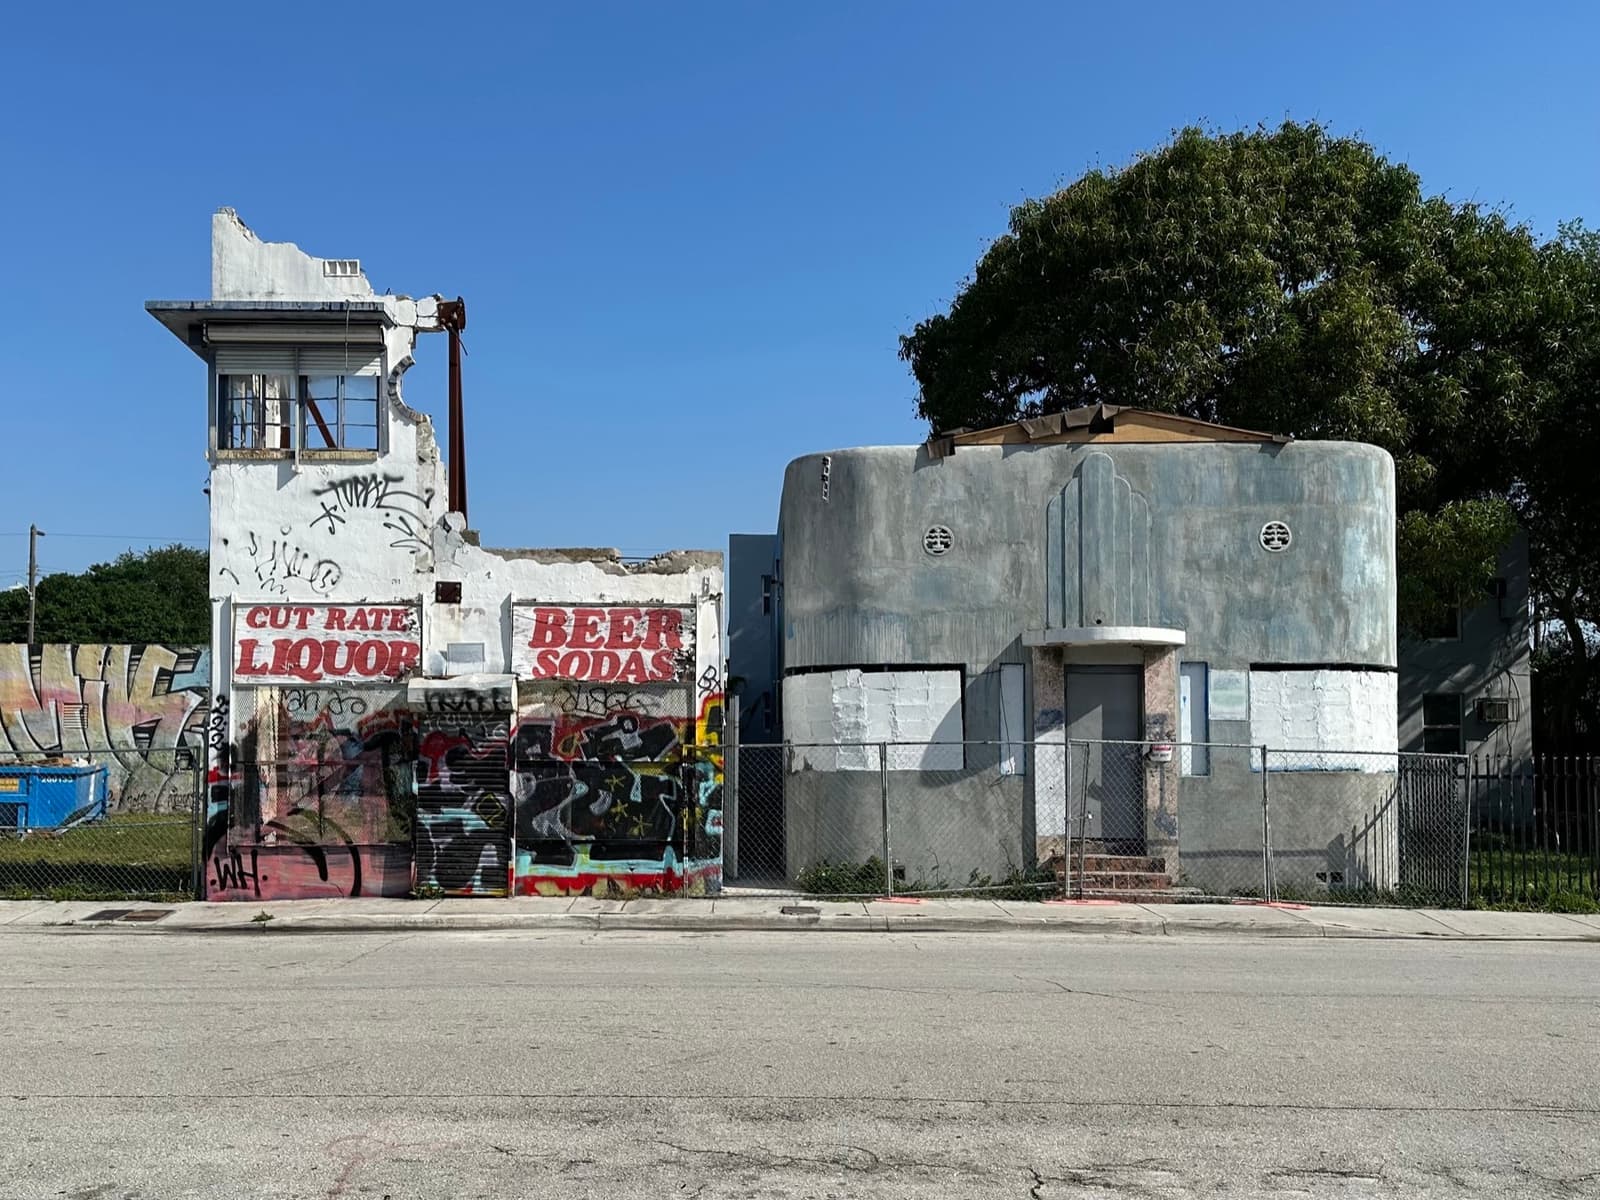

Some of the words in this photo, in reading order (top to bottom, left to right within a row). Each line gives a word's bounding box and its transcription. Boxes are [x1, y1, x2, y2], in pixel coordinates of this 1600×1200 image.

[246, 606, 315, 630] CUT
[323, 608, 409, 632] RATE
[528, 607, 684, 650] BEER
[235, 638, 420, 683] LIQUOR
[532, 649, 676, 683] SODAS
